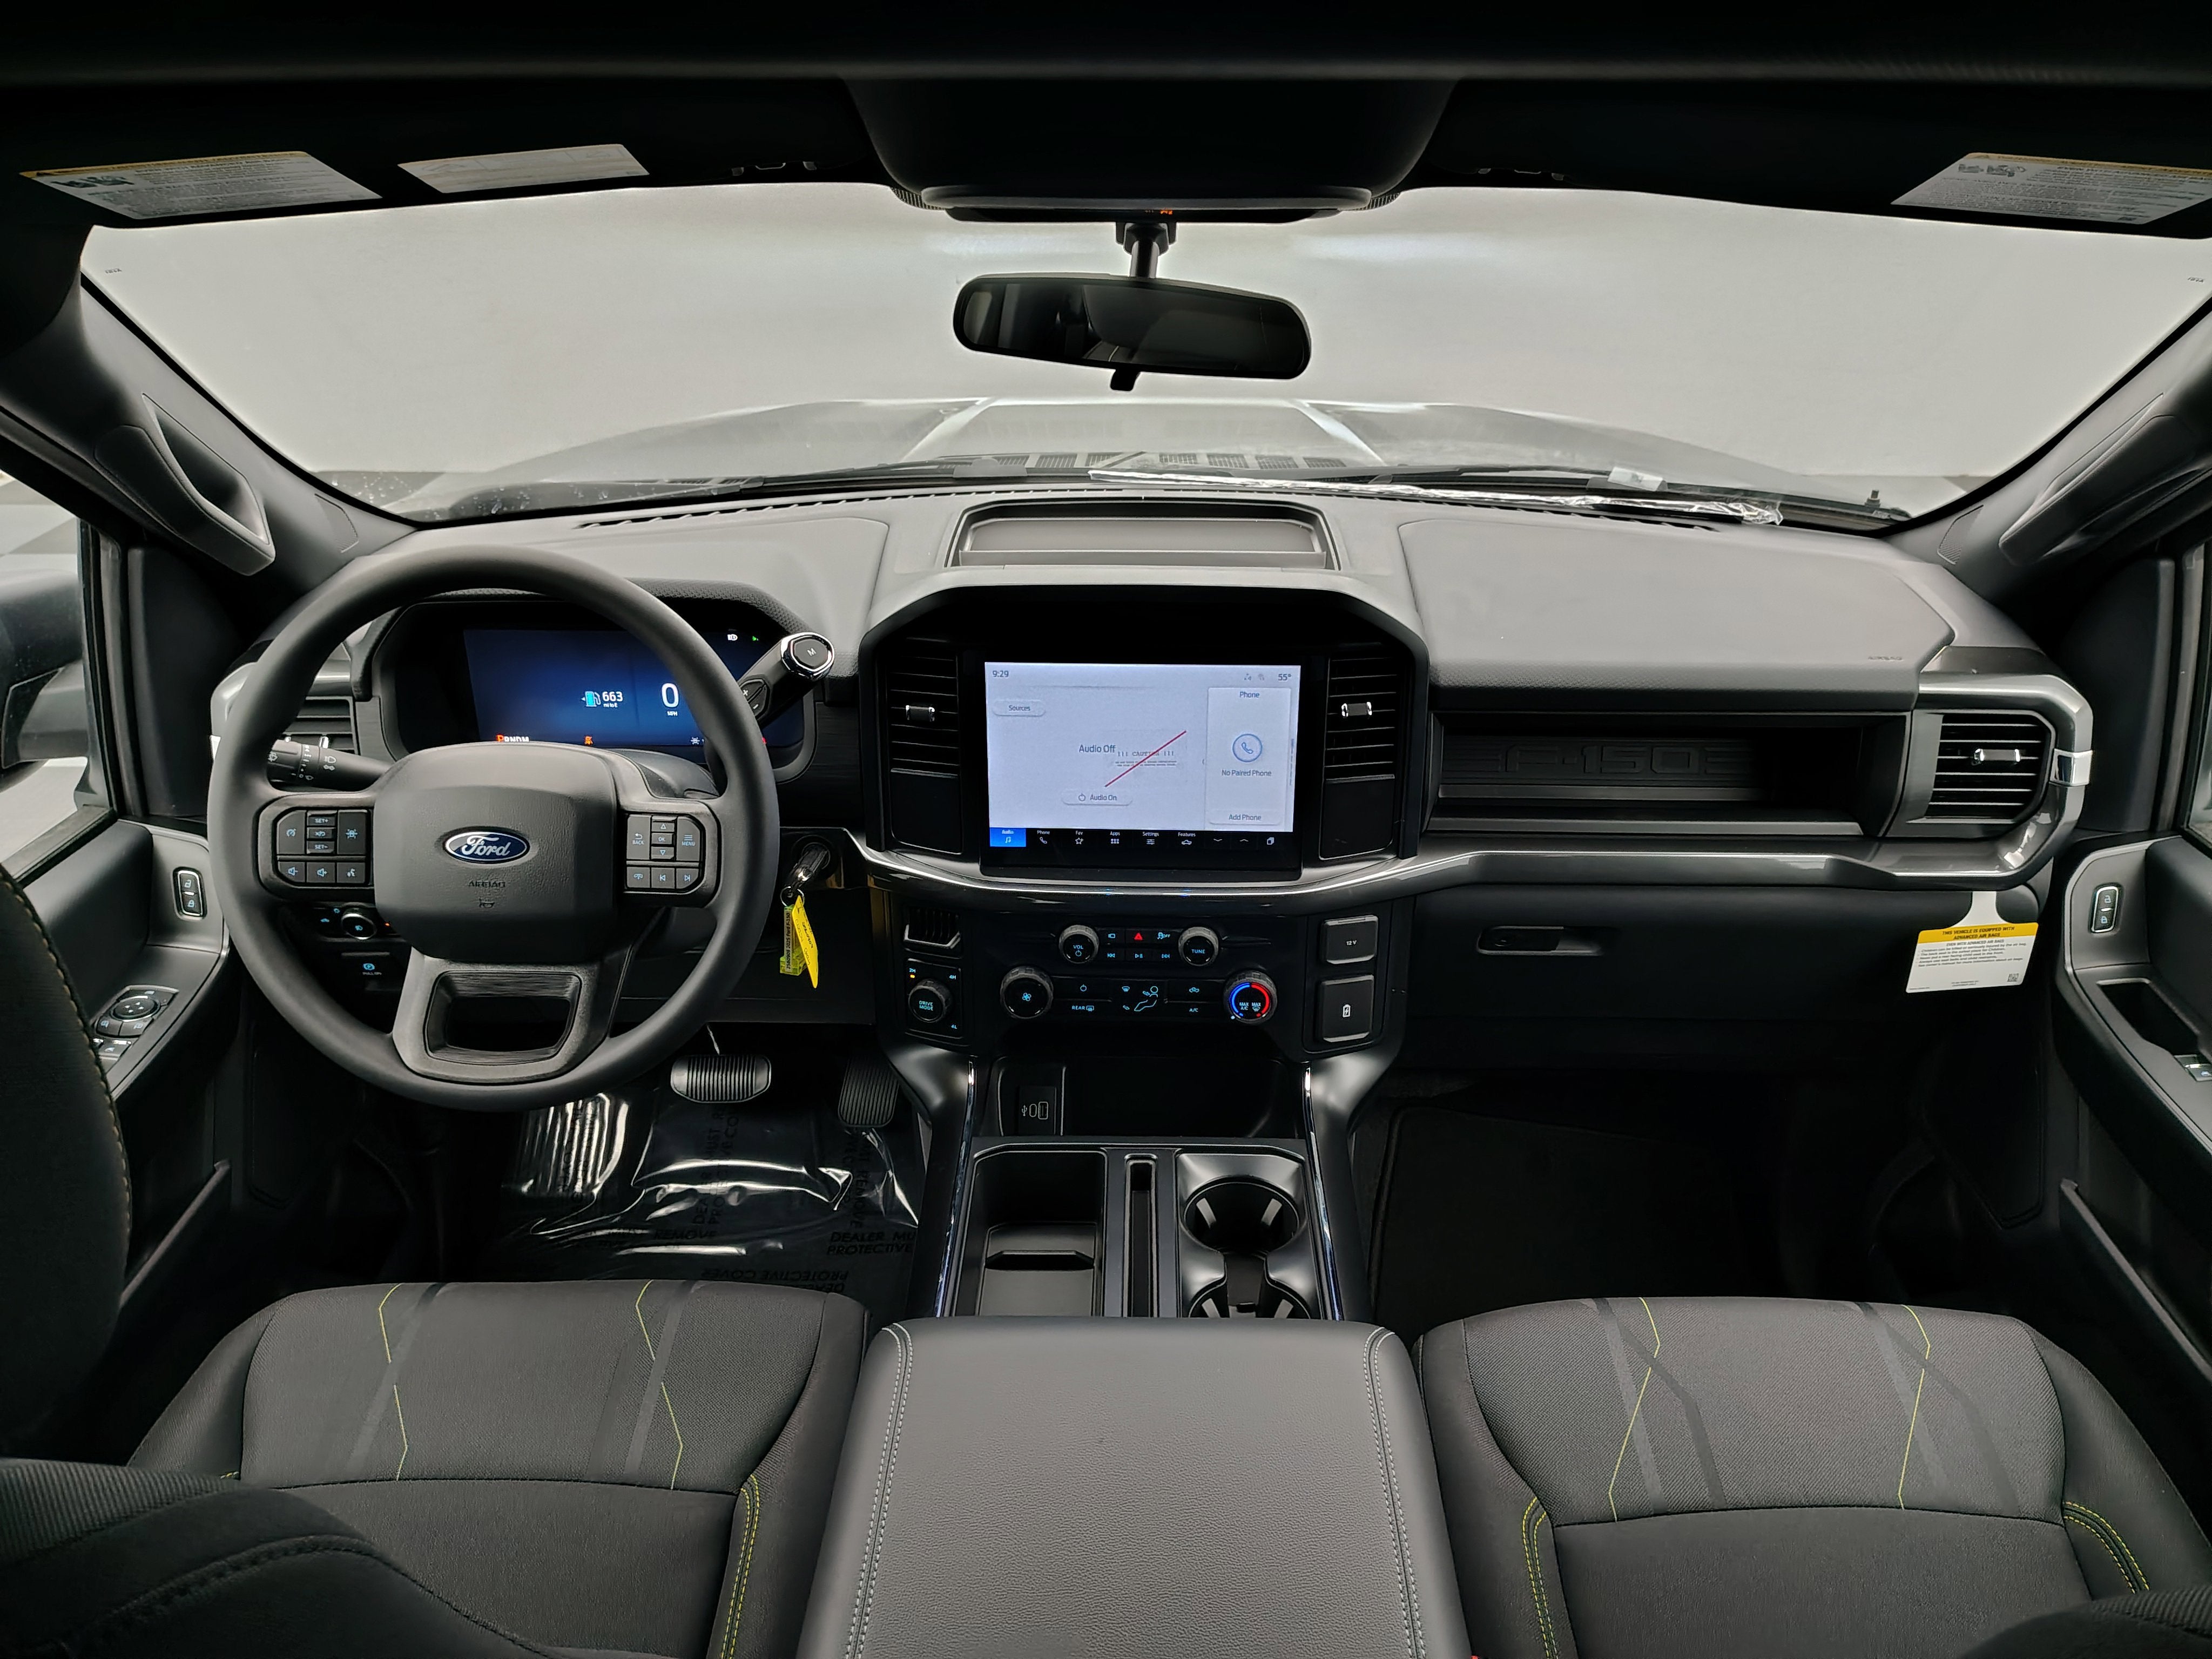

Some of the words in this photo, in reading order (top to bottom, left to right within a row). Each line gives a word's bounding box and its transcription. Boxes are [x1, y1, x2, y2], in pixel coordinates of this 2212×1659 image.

[602, 691, 623, 702] 663
[661, 683, 679, 707] 0
[1078, 745, 1102, 753] Audio
[1103, 745, 1116, 753] Off
[461, 835, 511, 856] Ford
[831, 1232, 885, 1243] DEALER
[893, 1231, 916, 1241] MU
[827, 1244, 913, 1255] PROTECTIVE
[760, 1270, 848, 1282] PROTECTIVE
